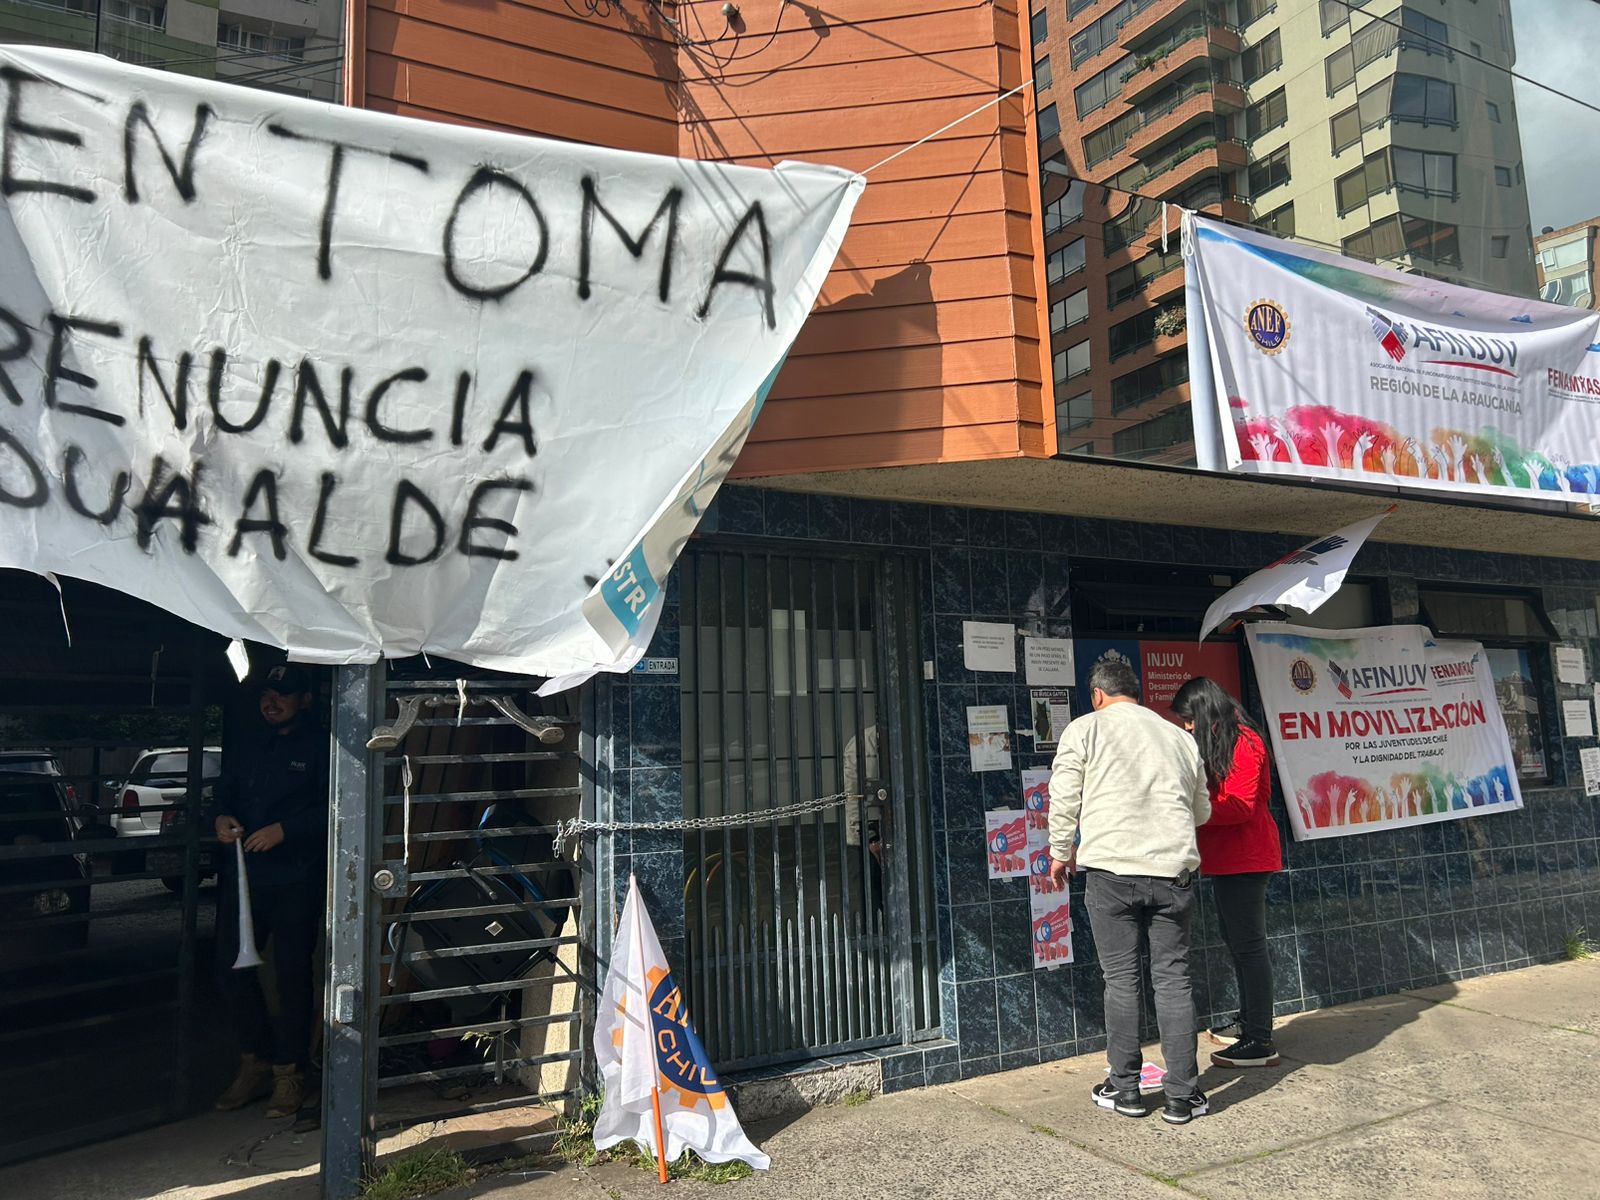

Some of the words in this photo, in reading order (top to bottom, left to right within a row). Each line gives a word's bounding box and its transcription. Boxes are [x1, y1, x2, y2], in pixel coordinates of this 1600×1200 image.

[0, 65, 216, 203] EN
[268, 123, 777, 329] TOMA
[1250, 306, 1281, 333] ANEF
[1255, 332, 1281, 347] CHILE
[1412, 322, 1520, 368] AFINJUV
[0, 309, 538, 457] RENUNCIA
[1370, 376, 1421, 397] REGIÓN
[1423, 384, 1440, 399] DE
[1442, 387, 1459, 403] LA
[1461, 391, 1522, 415] ARAUCANÍA
[649, 661, 676, 671] ENTRADA
[1146, 652, 1184, 668] INJUV
[1147, 671, 1182, 681] Ministerio
[1183, 672, 1191, 681] de
[1148, 682, 1182, 691] Desarroll
[1352, 664, 1427, 689] AFINJUV
[1149, 694, 1154, 703] y
[1155, 692, 1176, 702] Famili
[1278, 711, 1322, 741] EN
[1327, 692, 1487, 738] MOVILIZACIÓN
[1345, 741, 1361, 751] POR
[1363, 740, 1378, 750] LAS
[1378, 737, 1423, 749] JUVENTUDES
[1422, 736, 1433, 746] DE
[1433, 734, 1449, 745] CHILE
[1352, 755, 1358, 764] Y
[1359, 755, 1370, 764] LA
[1370, 752, 1404, 763] DIGNIDAD
[1404, 751, 1417, 761] DEL
[1417, 747, 1445, 760] TRABAJO
[657, 1029, 717, 1085] CHIL
